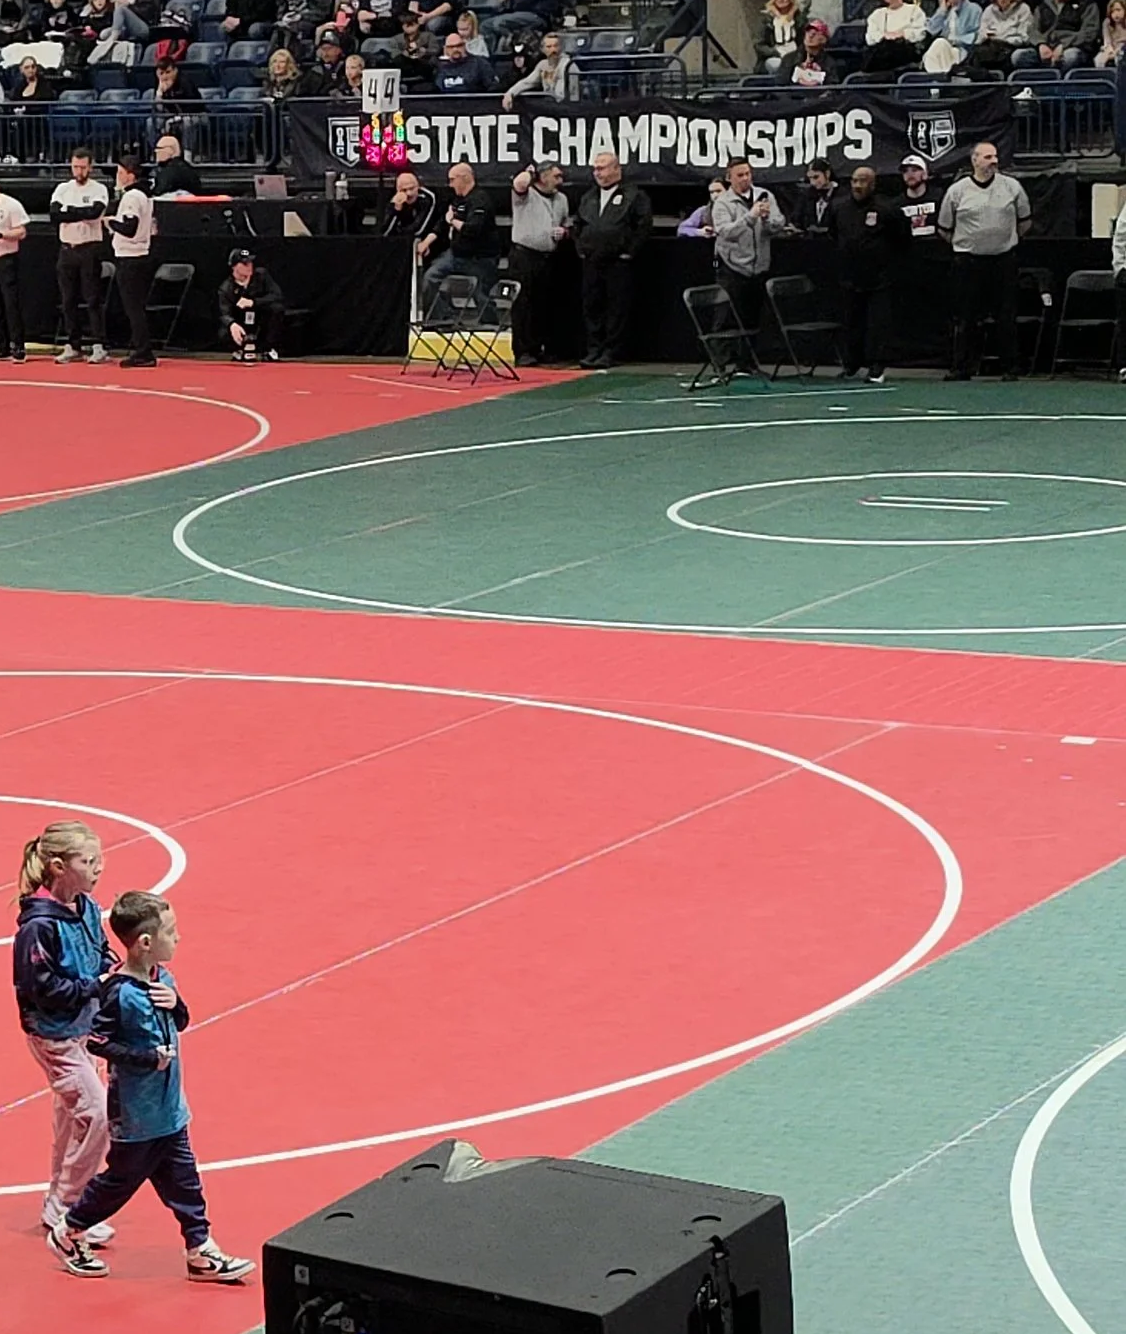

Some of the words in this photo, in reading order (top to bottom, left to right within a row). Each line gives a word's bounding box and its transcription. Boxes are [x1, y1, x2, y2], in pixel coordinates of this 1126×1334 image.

[368, 78, 377, 104] 4
[384, 77, 395, 104] 4
[406, 115, 519, 164] STATE
[532, 108, 873, 168] CHAMPIONSHIPS
